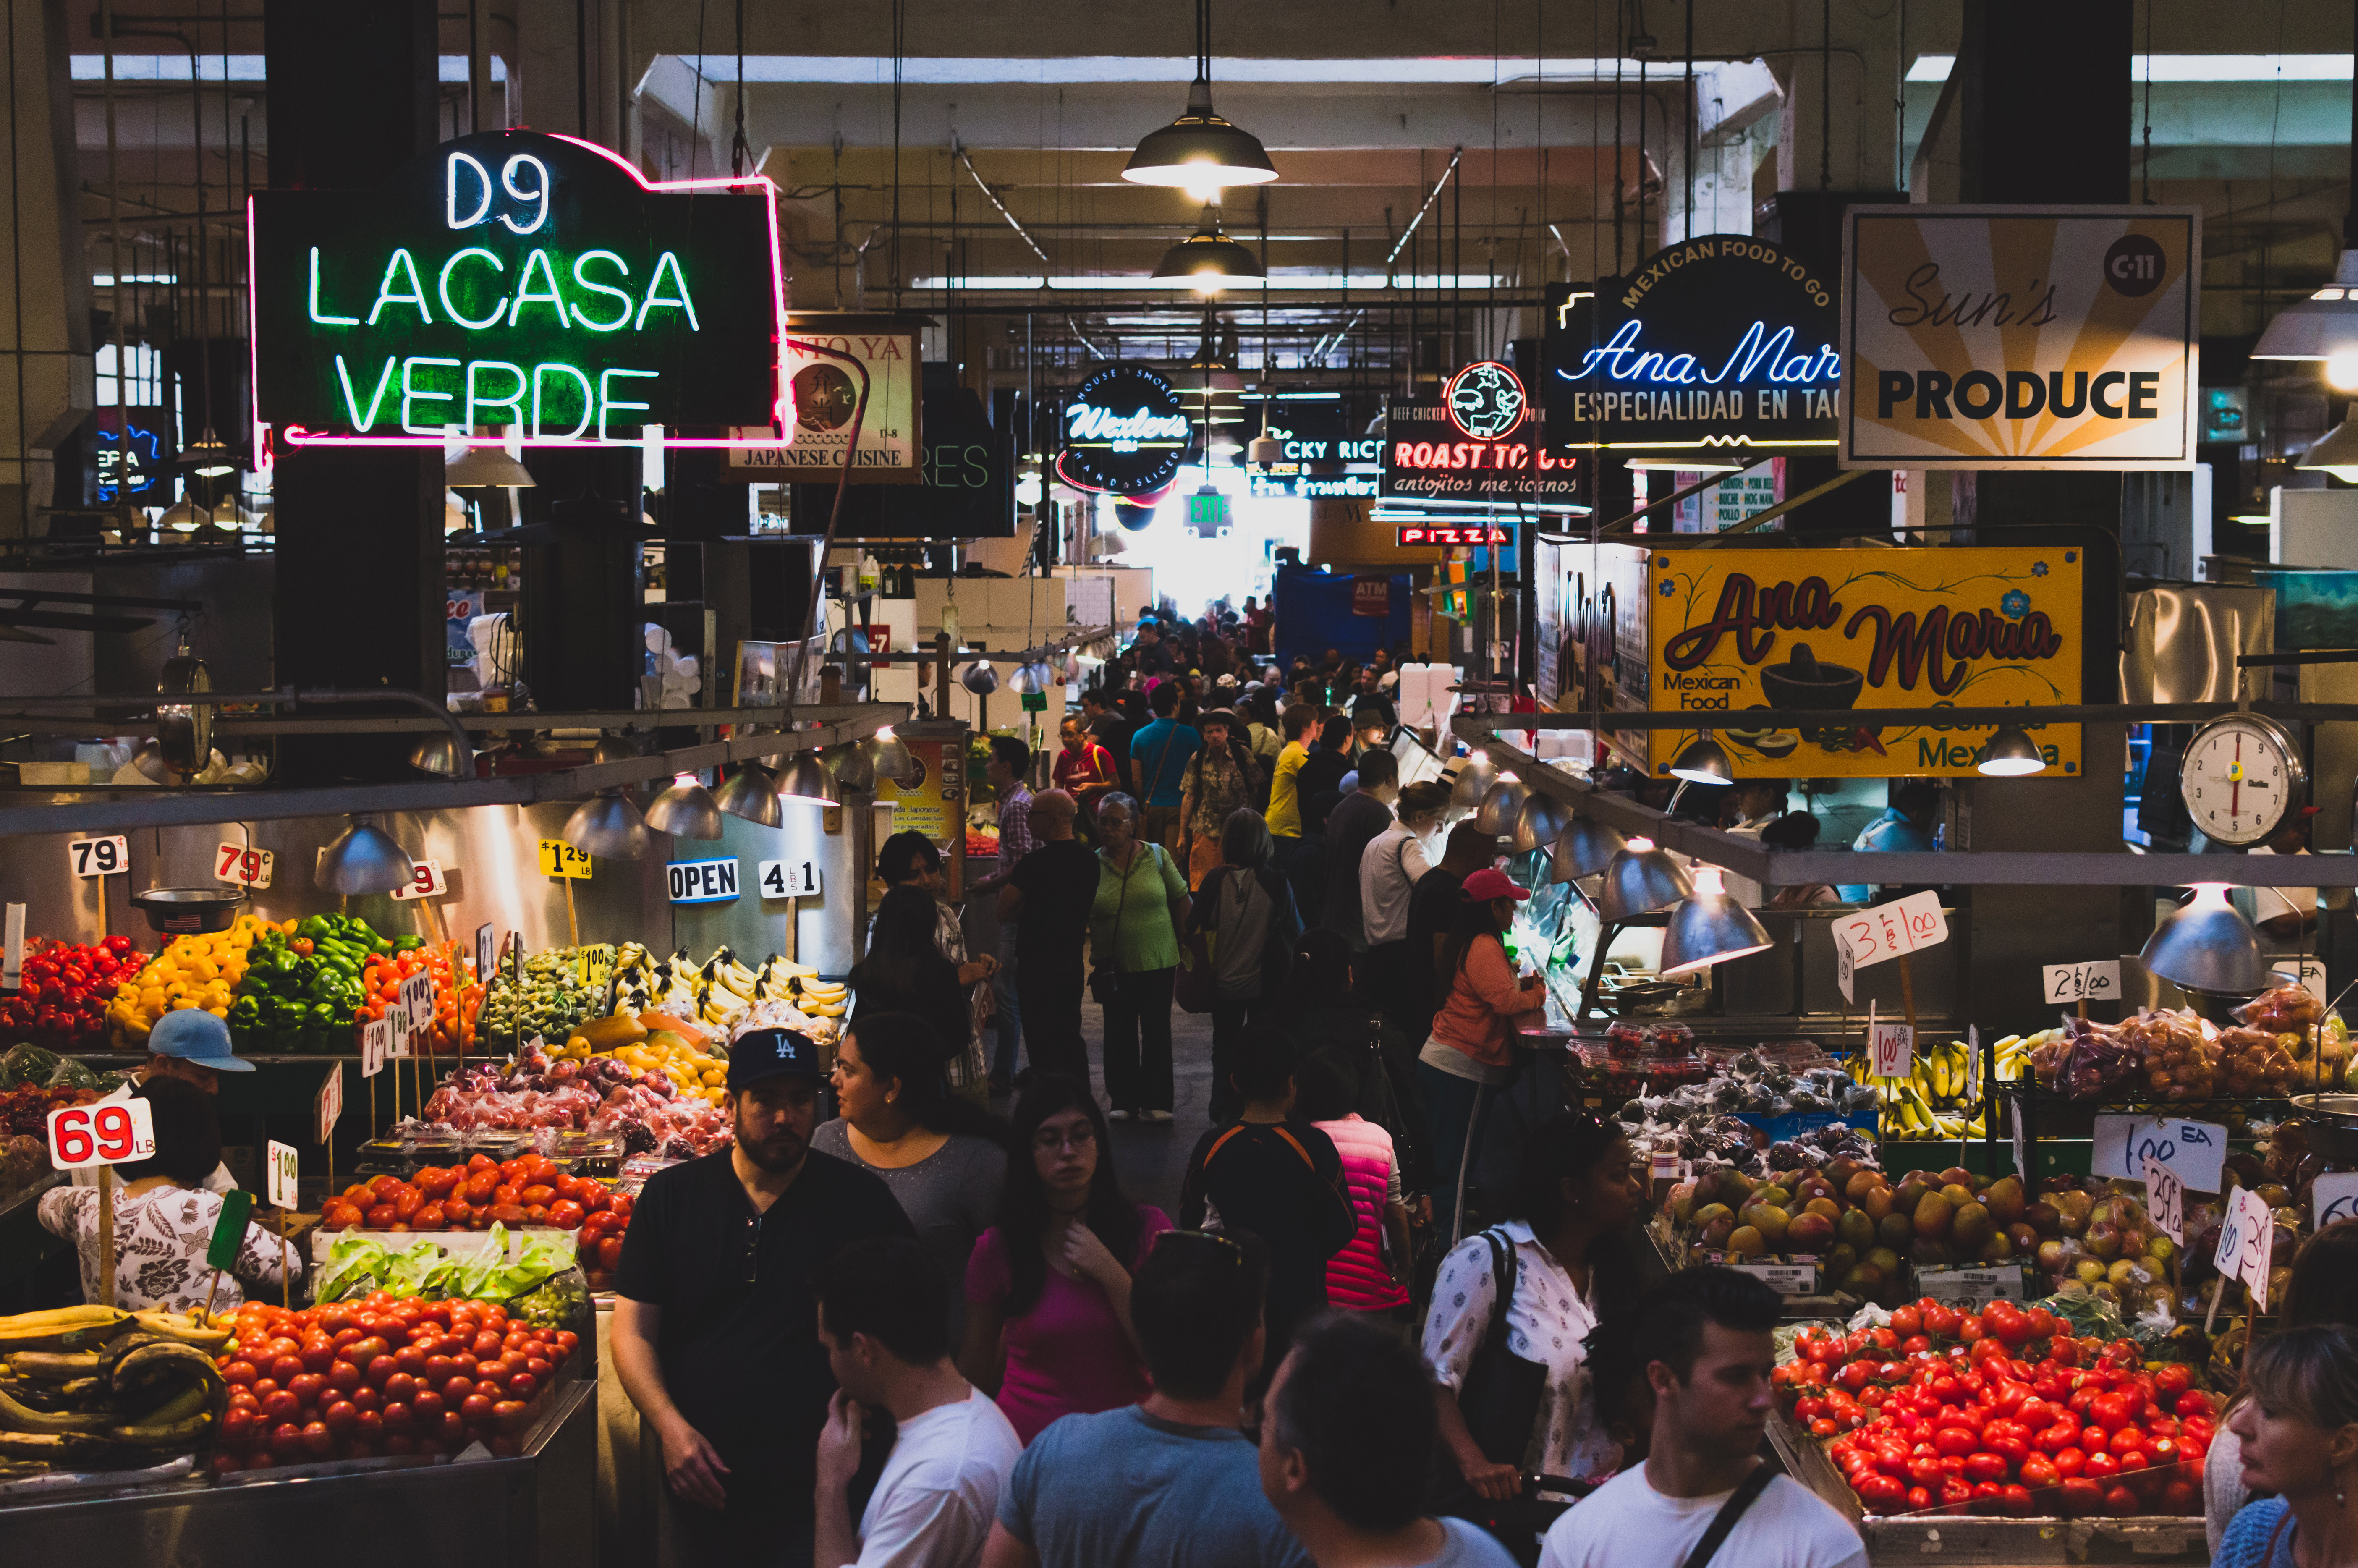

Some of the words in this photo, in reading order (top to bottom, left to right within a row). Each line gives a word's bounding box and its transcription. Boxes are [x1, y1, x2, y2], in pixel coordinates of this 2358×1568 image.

[448, 152, 550, 234] D9
[1621, 242, 1714, 309] MEXICAN
[1722, 241, 1777, 265] FOOD
[1781, 256, 1806, 280] TO
[1805, 278, 1829, 307] GO
[1888, 263, 2057, 327] Sun's
[860, 337, 903, 360] YA
[1558, 319, 1696, 383] Ana
[1077, 369, 1116, 400] HOUSE
[1137, 369, 1178, 404] SMOKED
[1878, 370, 2160, 420] PRODUCE
[335, 354, 660, 446] VERDE
[1574, 390, 1743, 421] ESPECIALIDAD
[1758, 390, 1787, 419] EN
[744, 449, 828, 466] JAPANESE
[832, 450, 902, 466] CUISINE
[1395, 442, 1487, 469] ROAST
[1494, 443, 1529, 469] TO
[1073, 452, 1117, 487] HAND
[1136, 451, 1178, 487] SLICED
[1393, 474, 1472, 498] antojitos
[1191, 496, 1224, 523] EXIT
[1403, 529, 1507, 543] PIZZA
[1355, 582, 1387, 595] ATM
[1663, 572, 1842, 671] Ana
[1843, 604, 2062, 696] Maria
[1663, 673, 1740, 691] Mexican
[1680, 692, 1729, 710] Food
[1918, 737, 2059, 767] Mexa
[2258, 743, 2264, 754] 9
[2197, 760, 2203, 770] 2
[2272, 765, 2278, 777] 8
[2196, 788, 2202, 798] 3
[2273, 794, 2278, 805] 7
[2209, 810, 2215, 821] 4
[2232, 821, 2238, 832] 5
[2256, 814, 2262, 825] 6
[260, 873, 270, 882] LB
[670, 862, 736, 898] OPEN
[764, 864, 784, 893] 4
[802, 861, 814, 891] 1
[1849, 922, 1876, 962] 3
[2054, 970, 2071, 998] 2
[2302, 966, 2322, 979] EA
[775, 1033, 796, 1058] LA
[54, 1106, 134, 1163] 69
[136, 1139, 156, 1154] LB
[2181, 1126, 2212, 1147] EA
